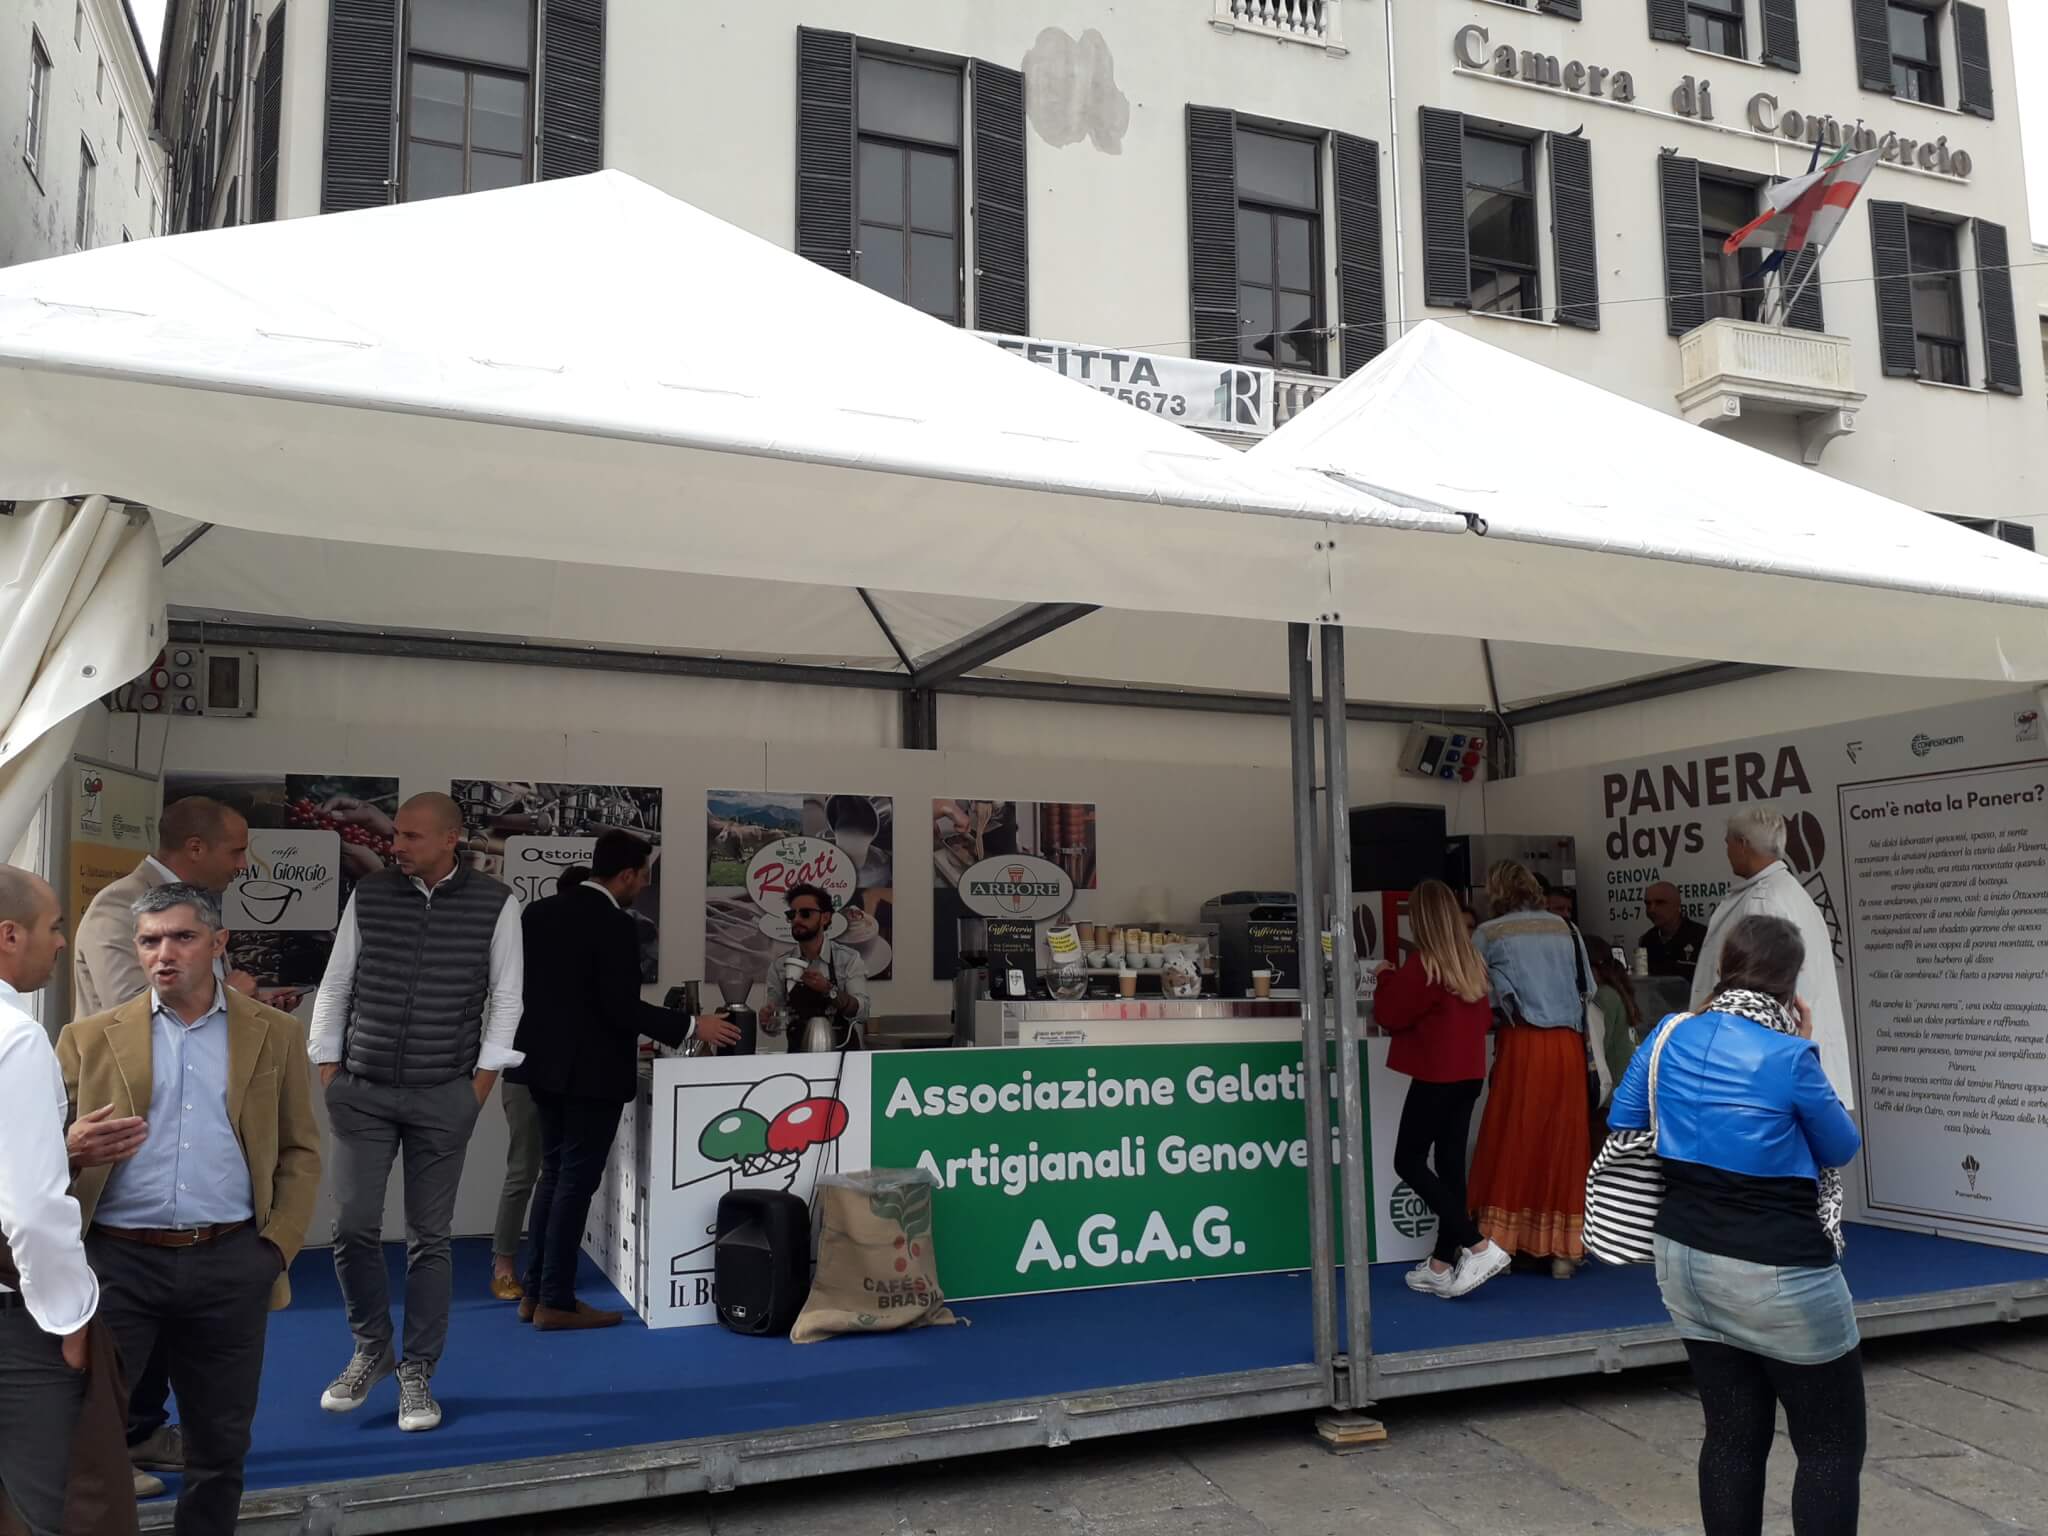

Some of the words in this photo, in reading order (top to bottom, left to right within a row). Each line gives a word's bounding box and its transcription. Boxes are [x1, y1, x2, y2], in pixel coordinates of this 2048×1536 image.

[1453, 23, 1636, 102] Camera
[1672, 75, 1715, 121] di
[1747, 92, 1972, 176] Commercio
[1603, 746, 1812, 819] PANERA
[1849, 801, 1900, 821] Com'è
[1903, 799, 1942, 815] nata
[1946, 794, 1963, 811] la
[1967, 784, 2045, 808] Panera?
[521, 848, 593, 864] astoria
[1606, 815, 1705, 868] days
[753, 850, 838, 900] Reati
[972, 884, 1059, 896] ARBORE
[1607, 868, 1660, 884] GENOVA
[1608, 887, 1645, 903] PIAZZ
[1609, 906, 1640, 920] 5-6-7
[885, 1067, 1175, 1119] Associazione
[915, 1135, 1146, 1196] Artigianali
[1157, 1126, 1340, 1175] Genovei
[1016, 1206, 1246, 1273] A.G.A.G.
